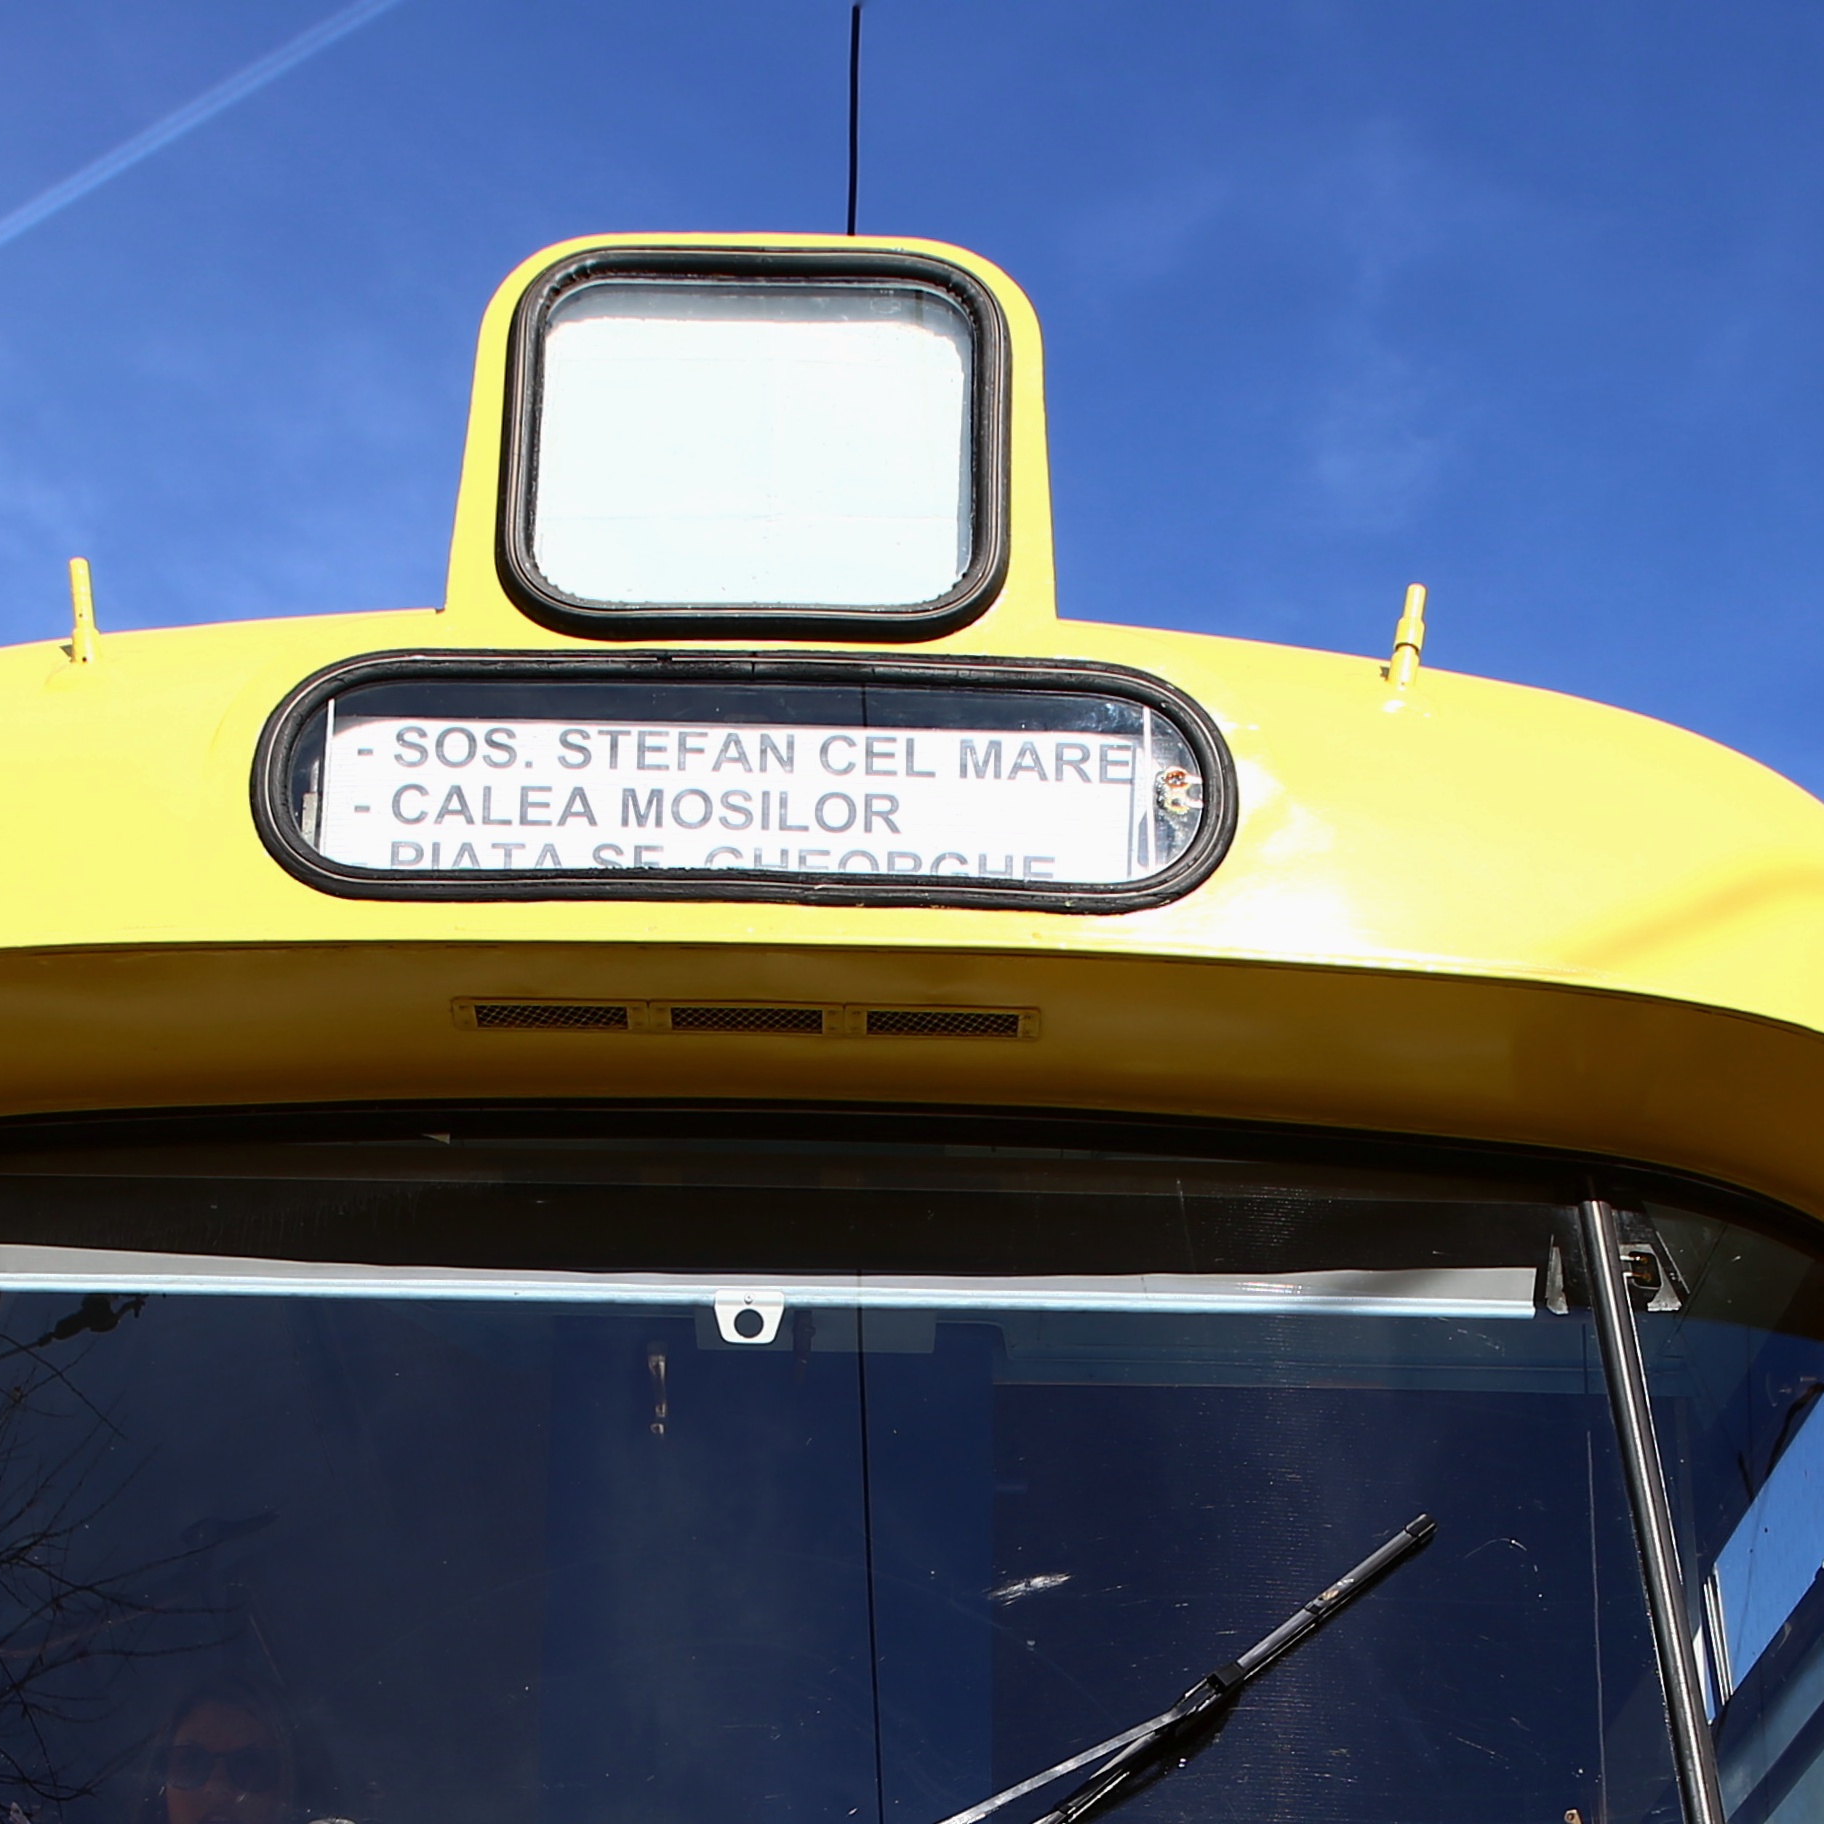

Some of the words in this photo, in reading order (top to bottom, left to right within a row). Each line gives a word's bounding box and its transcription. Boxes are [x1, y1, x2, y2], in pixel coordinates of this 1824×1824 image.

[393, 725, 534, 769] SOS.
[557, 727, 796, 775] STEFAN
[819, 733, 937, 779] CEL
[958, 738, 1133, 785] MARE
[391, 783, 598, 827] CALEA
[620, 786, 901, 834] MOSILOR
